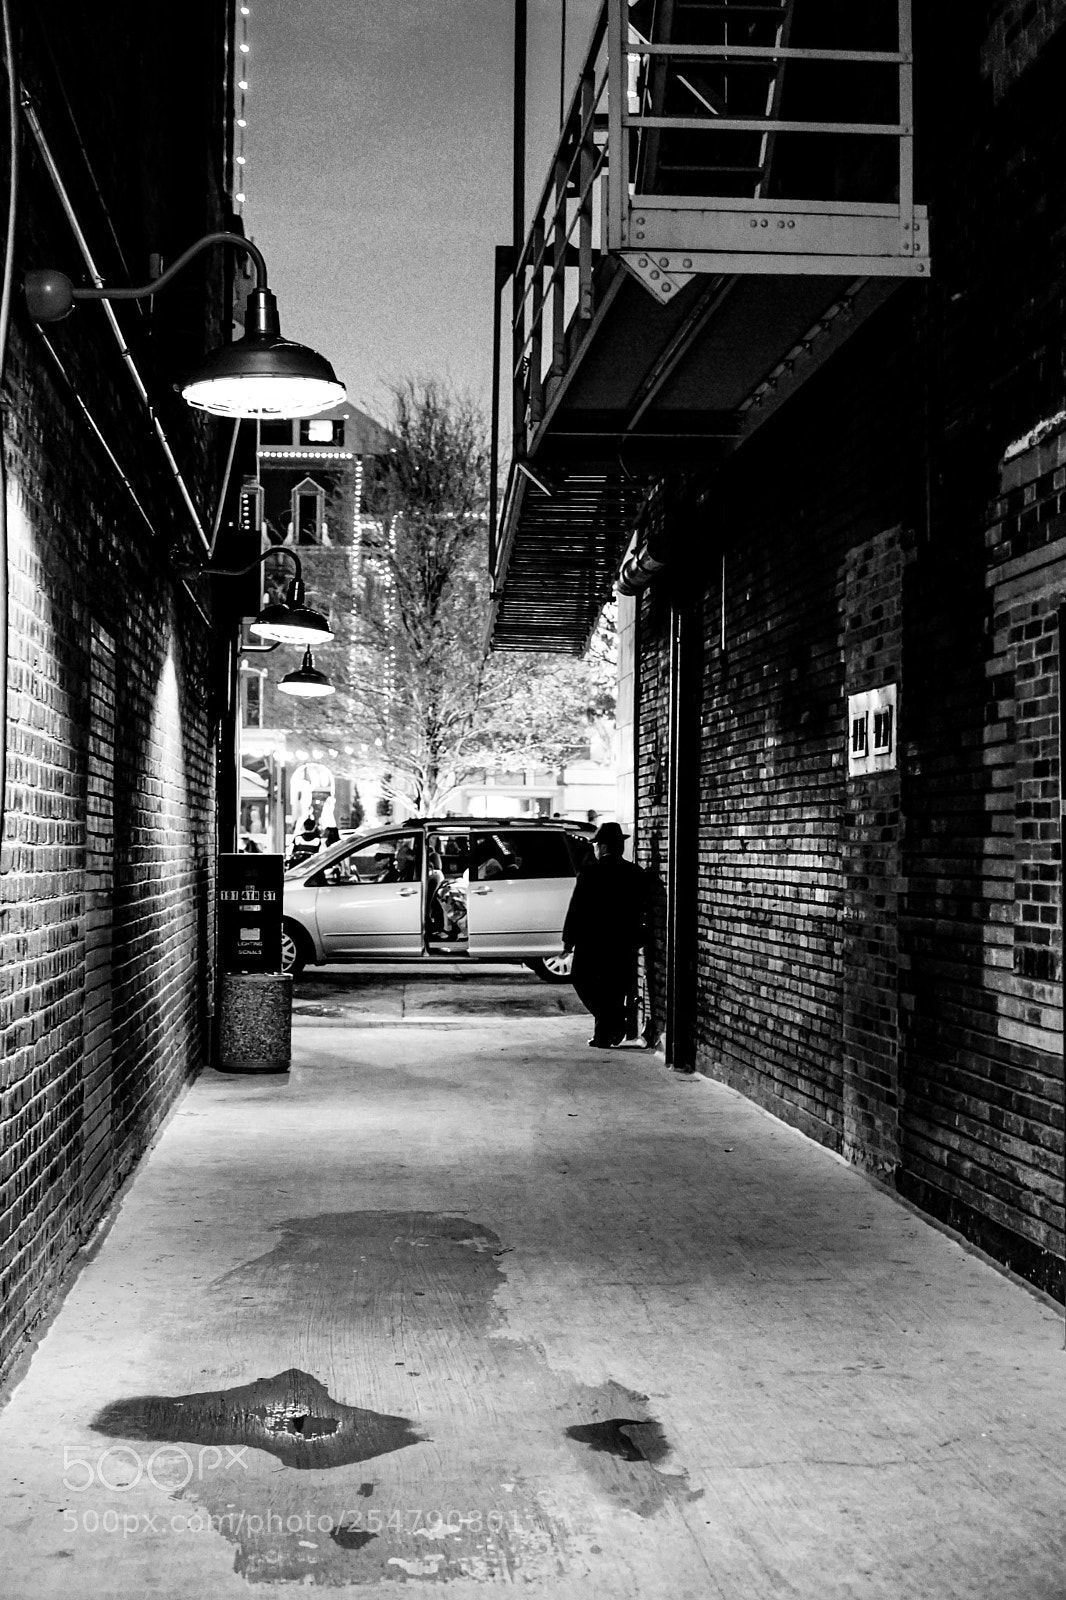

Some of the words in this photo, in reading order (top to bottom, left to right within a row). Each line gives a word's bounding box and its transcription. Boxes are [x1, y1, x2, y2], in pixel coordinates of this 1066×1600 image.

[220, 890, 239, 901] 191
[241, 890, 260, 901] 4TH
[263, 890, 276, 901] ST
